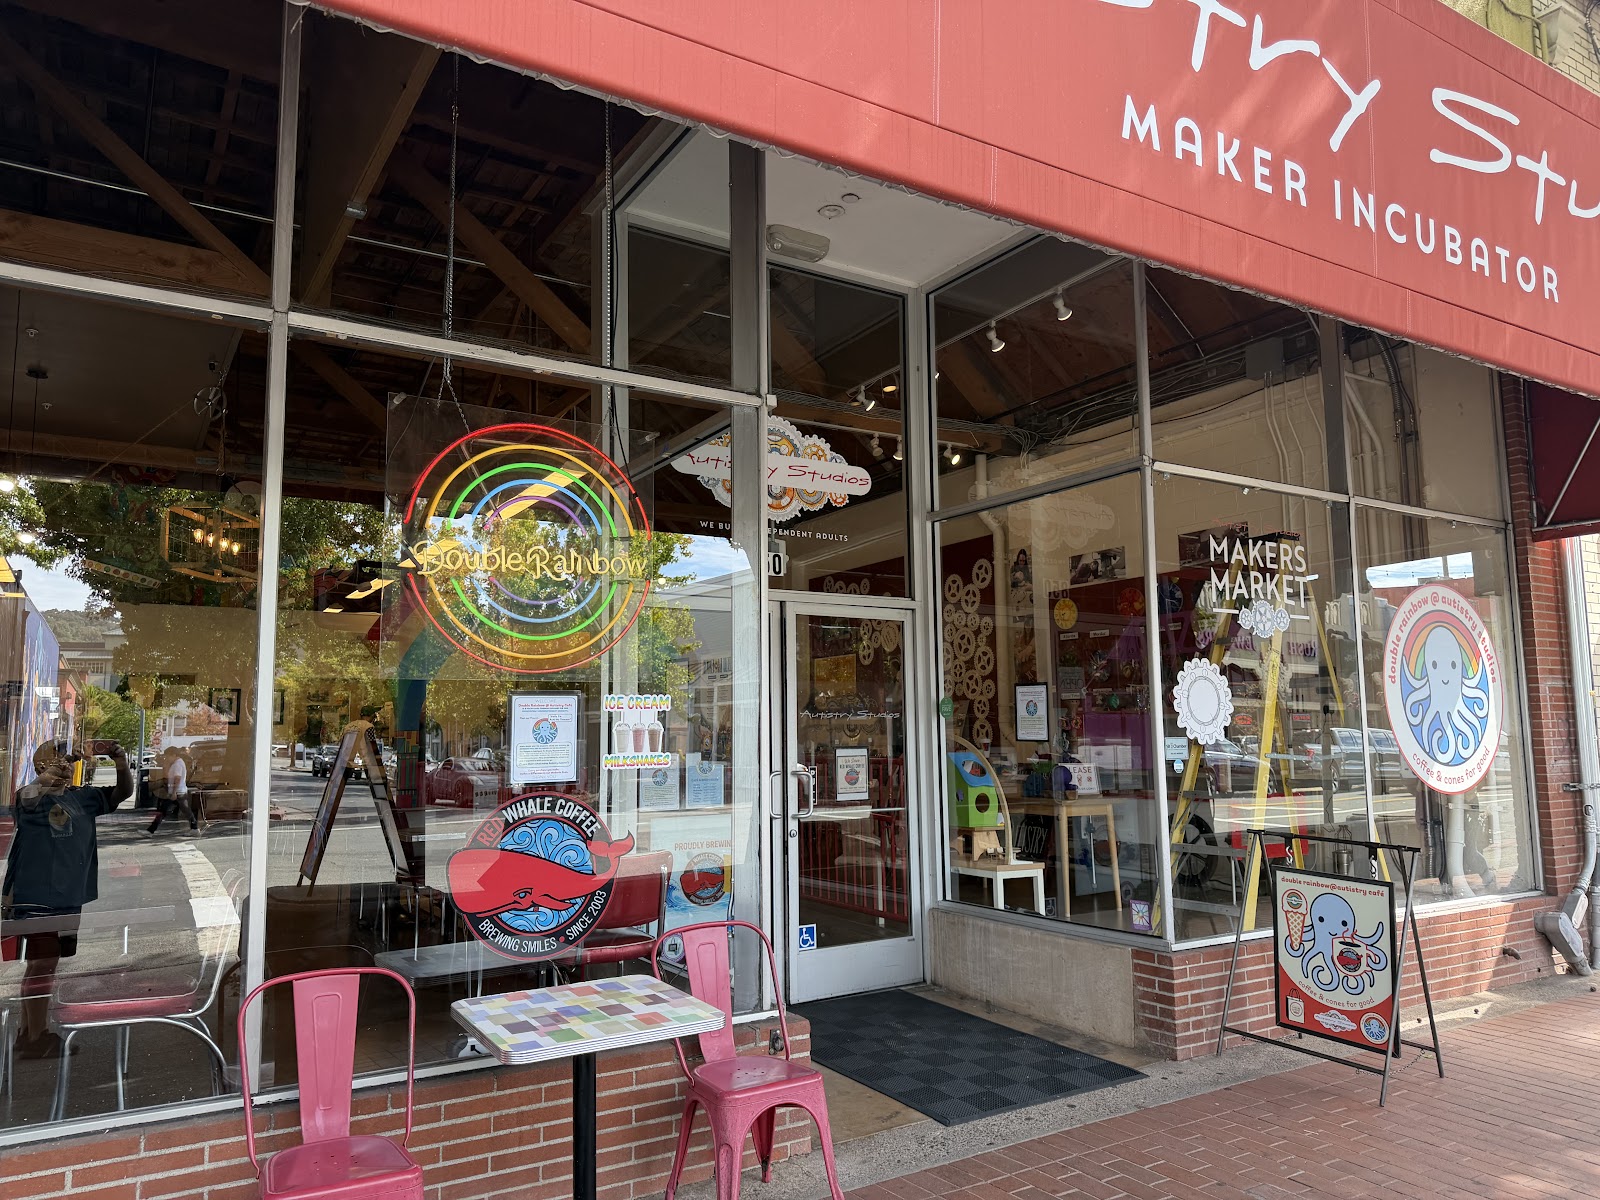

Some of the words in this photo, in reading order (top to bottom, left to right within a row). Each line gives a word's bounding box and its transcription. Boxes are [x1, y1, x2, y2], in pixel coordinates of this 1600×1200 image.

[1084, 0, 1381, 152] try
[1121, 94, 1307, 207] MAKER
[1334, 179, 1560, 303] INCUBATOR
[787, 464, 870, 487] Studios
[700, 520, 715, 530] WE
[815, 531, 849, 543] ADULTS
[410, 540, 523, 576] Double
[527, 546, 648, 582] Rainbow
[768, 553, 782, 575] 0
[1209, 533, 1307, 573] MAKERS
[1210, 567, 1308, 608] MARKET
[1388, 635, 1402, 684] double
[1399, 596, 1429, 634] rainbow
[1430, 592, 1440, 606] @
[1441, 595, 1478, 632] autistry
[1477, 630, 1497, 684] studios
[605, 696, 624, 710] ICE
[627, 695, 670, 710] CREAM
[800, 710, 854, 721] Autistry
[857, 710, 900, 719] Studios
[604, 754, 670, 768] MILKSHAKES
[1412, 752, 1435, 779] coffee
[1436, 771, 1442, 783] &
[1444, 775, 1465, 785] cones
[1465, 766, 1475, 780] for
[1476, 747, 1490, 773] good
[476, 816, 505, 847] RED
[502, 797, 552, 825] WHALE
[555, 798, 602, 838] COFFEE
[674, 841, 704, 851] PROUDLY
[1281, 876, 1302, 885] double
[1368, 889, 1385, 898] café
[565, 915, 593, 941] SINCE
[587, 890, 607, 918] 2003
[478, 918, 520, 952] BREWING
[521, 936, 557, 954] SMILES
[1298, 980, 1318, 998] coffee
[1319, 993, 1324, 1001] &
[1325, 997, 1345, 1008] cones
[1359, 997, 1375, 1010] good
